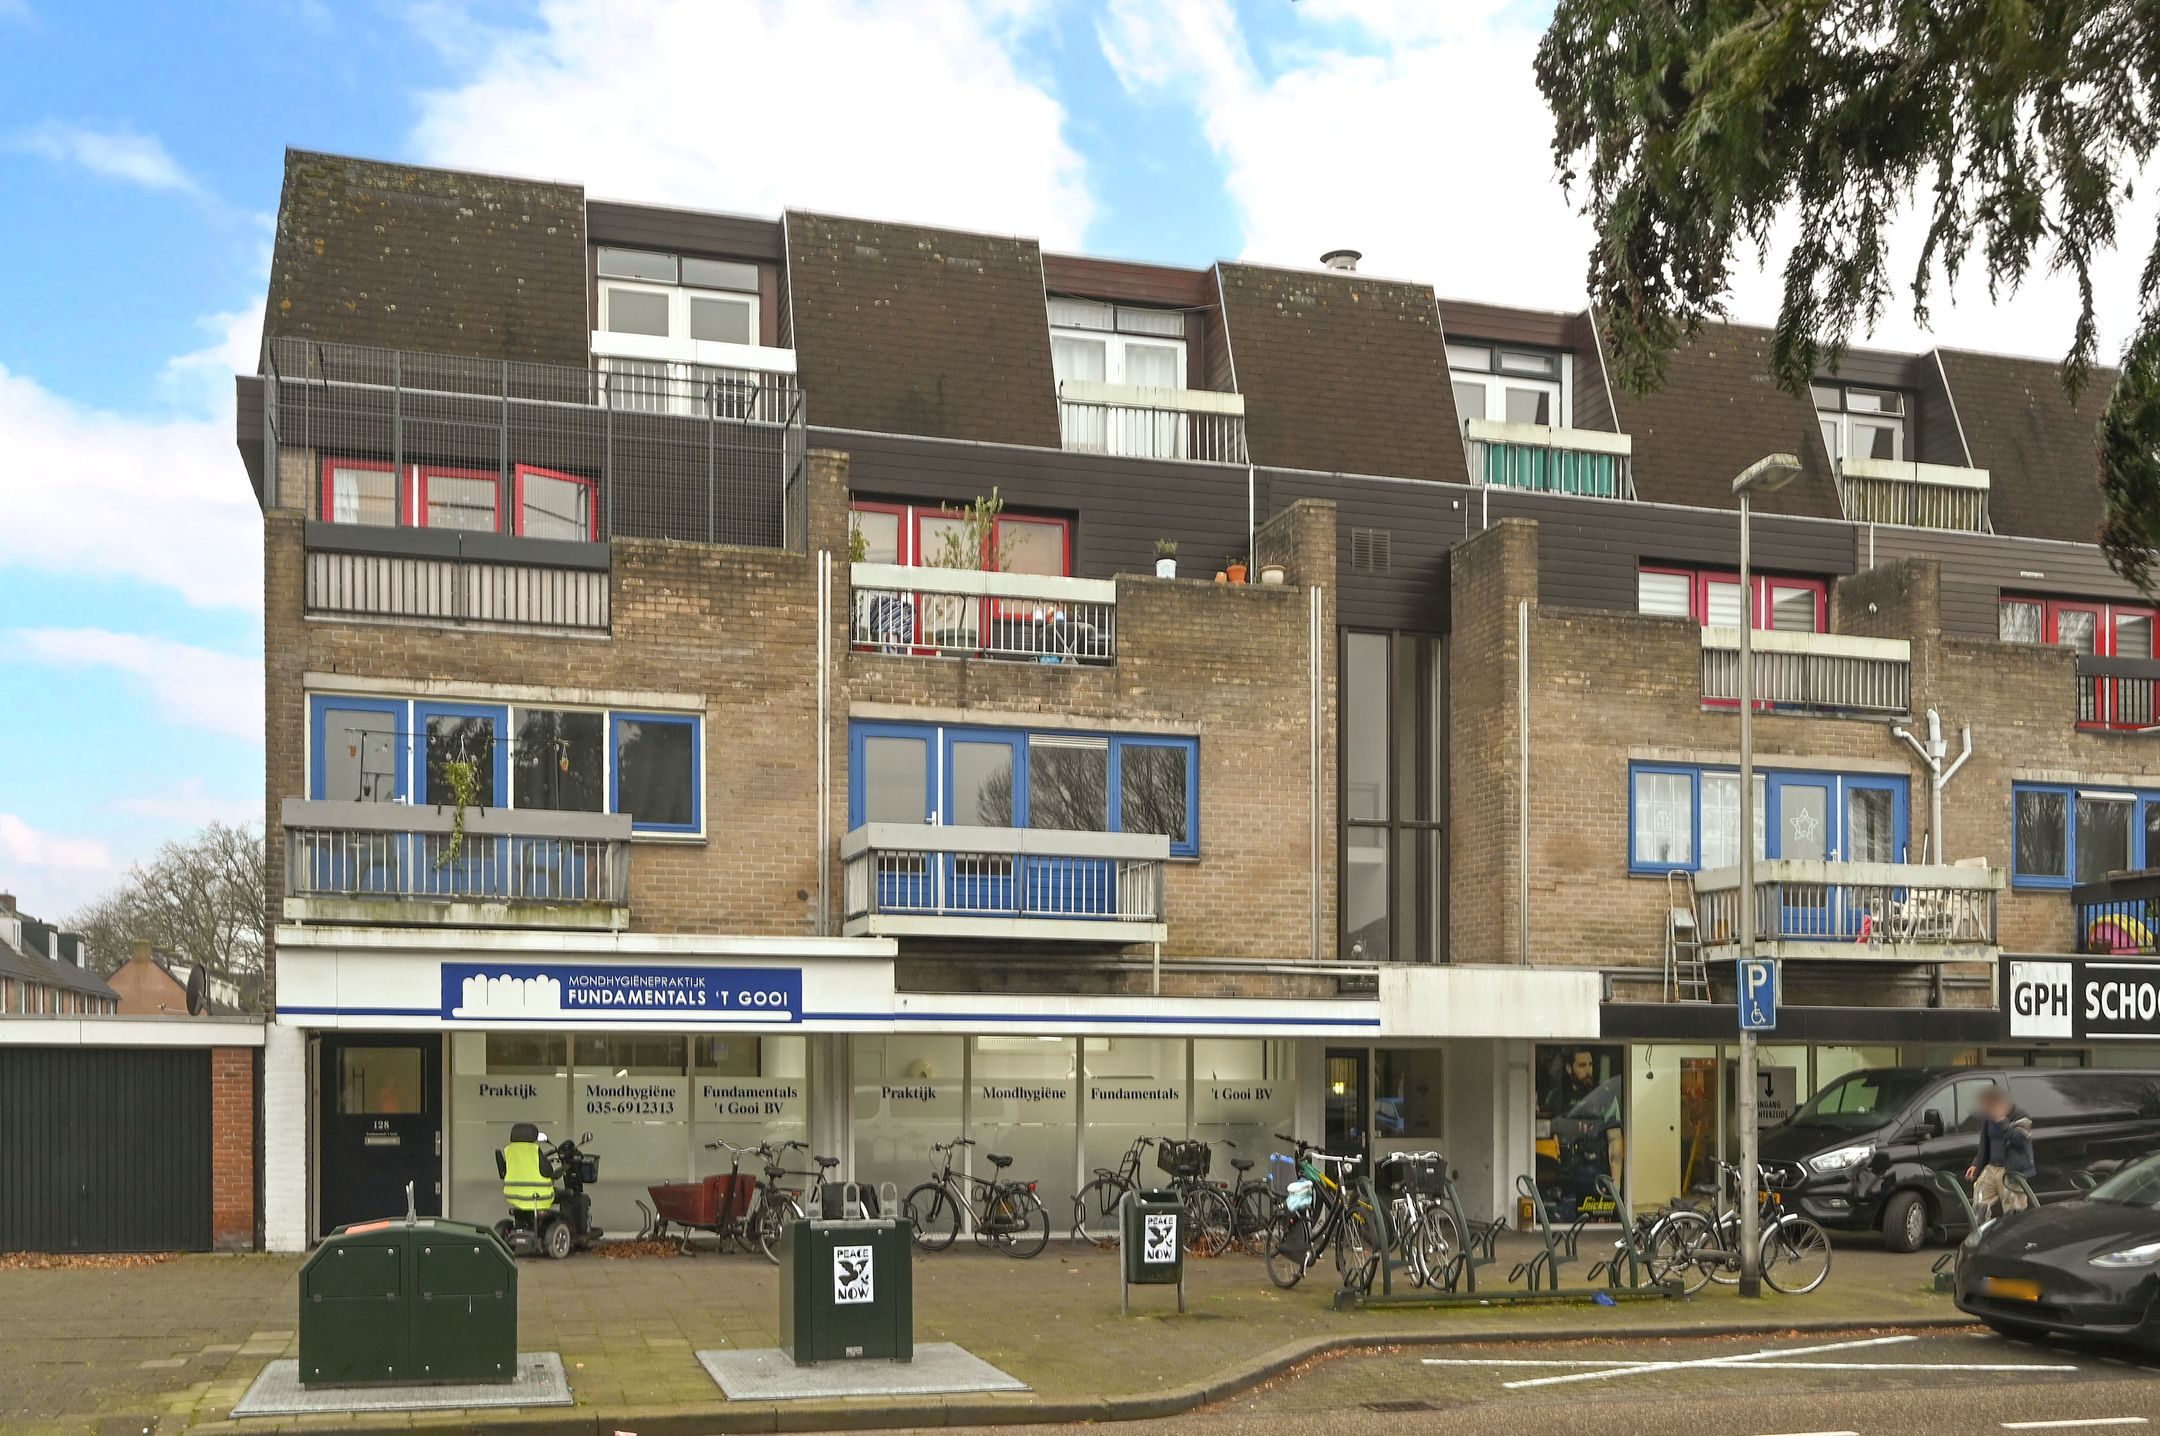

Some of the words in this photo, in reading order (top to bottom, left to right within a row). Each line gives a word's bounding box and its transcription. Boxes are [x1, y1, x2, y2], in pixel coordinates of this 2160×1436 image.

[569, 975, 706, 989] MONDHYGIËNEPRAKTIJK
[1748, 964, 1767, 1000] P
[569, 990, 706, 1006] FUNDAMENTALS
[716, 991, 729, 1007] 'T
[738, 991, 788, 1007] GOOI
[2014, 981, 2068, 1017] GPH
[2085, 981, 2160, 1021] SCHO
[479, 1084, 537, 1099] Praktijk
[586, 1085, 676, 1100] Mondhygiëne
[703, 1085, 798, 1099] Fundamentals
[881, 1087, 936, 1102] Praktijk
[983, 1087, 1067, 1102] Mondhygiëne
[1091, 1087, 1180, 1100] Fundamentals
[1211, 1088, 1220, 1100] 't
[1222, 1088, 1251, 1100] Gooi
[1255, 1088, 1273, 1100] BV
[586, 1102, 675, 1114] 035-6912313
[714, 1102, 724, 1114] 't
[727, 1102, 759, 1115] Gooi
[764, 1103, 784, 1115] BV
[373, 1120, 390, 1130] 128
[1147, 1217, 1174, 1225] PEACE
[837, 1248, 869, 1259] PEACE
[1147, 1249, 1173, 1260] NOW
[837, 1286, 870, 1300] NOW
